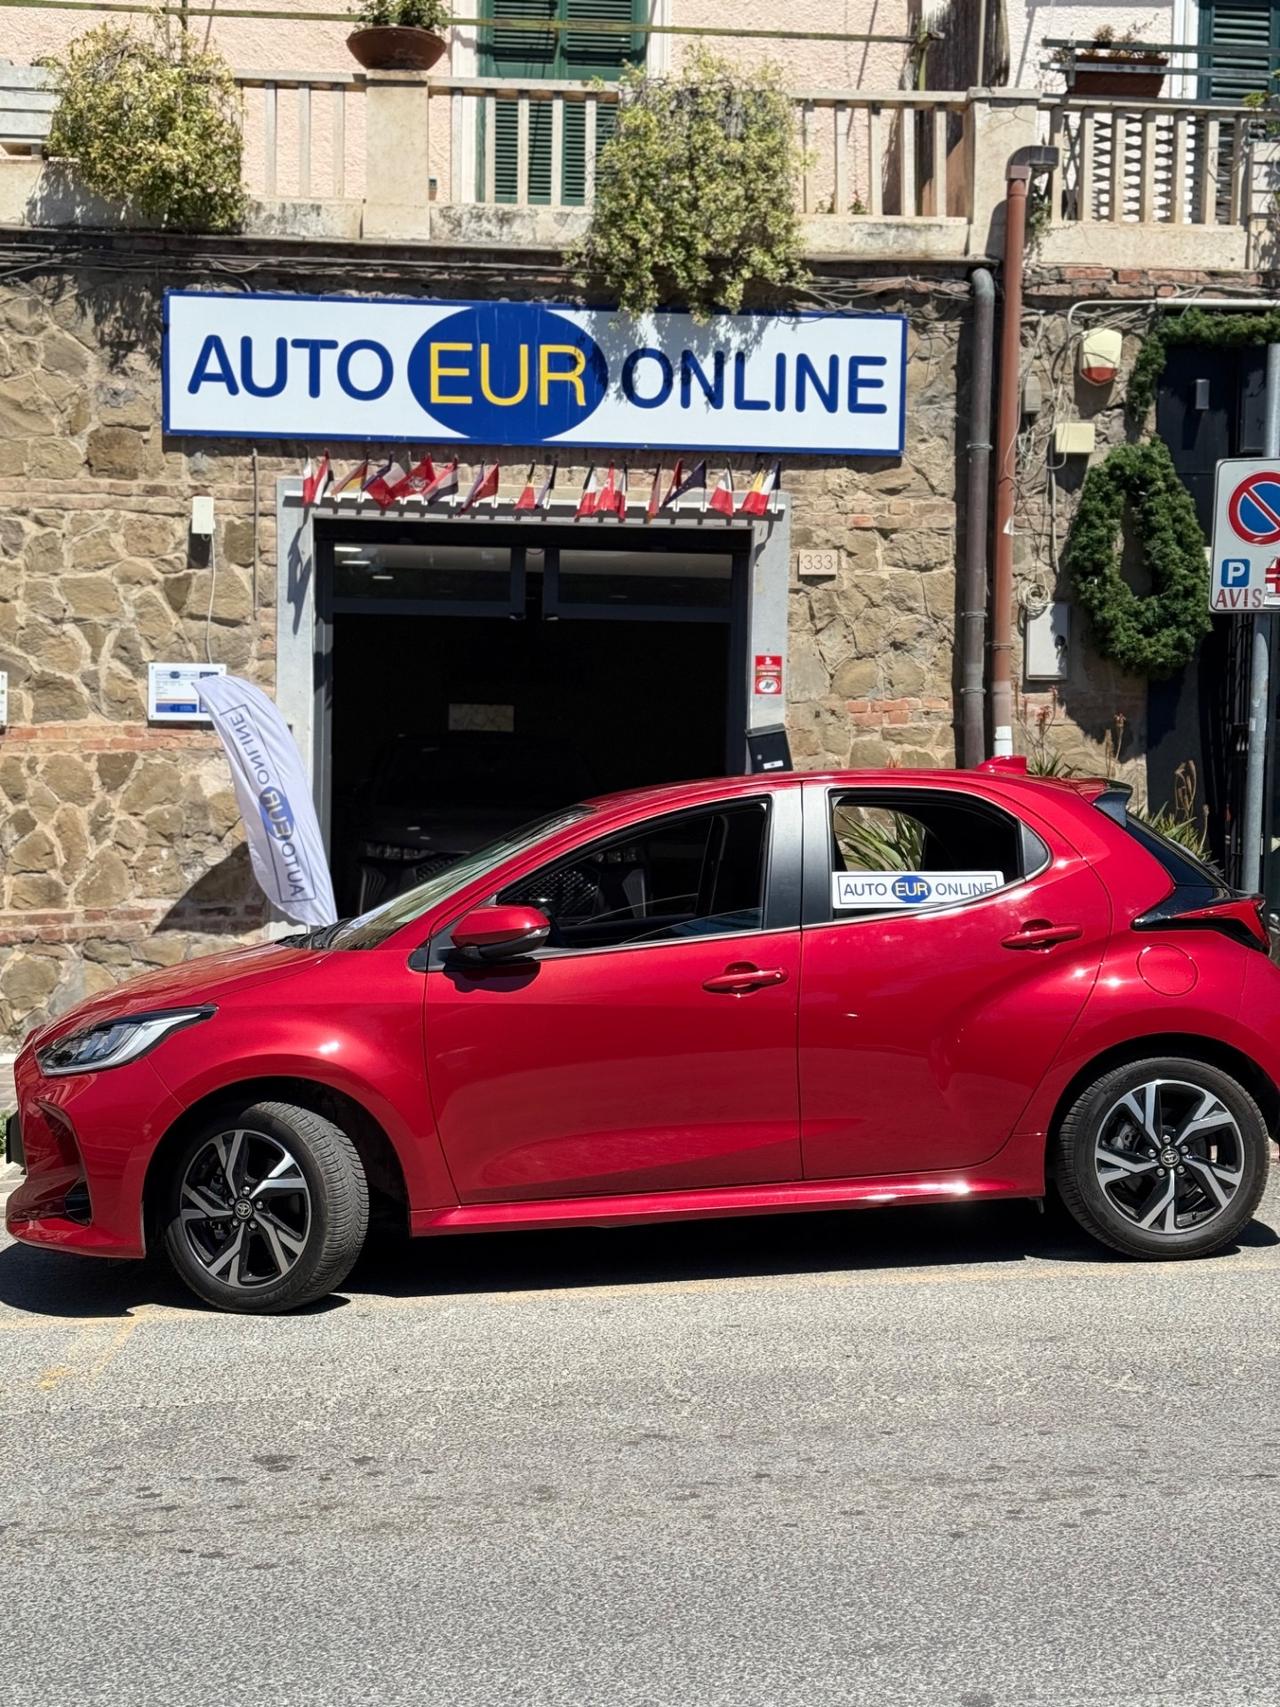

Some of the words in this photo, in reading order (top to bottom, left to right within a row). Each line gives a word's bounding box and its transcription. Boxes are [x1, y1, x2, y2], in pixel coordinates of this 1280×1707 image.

[187, 334, 394, 402] AUTO
[429, 341, 587, 407] EUR
[621, 347, 888, 414] ONLINE
[803, 554, 834, 570] 333
[1227, 561, 1246, 585] P
[1214, 588, 1263, 608] AVIS
[843, 882, 888, 897] AUTO
[894, 882, 929, 897] EUR
